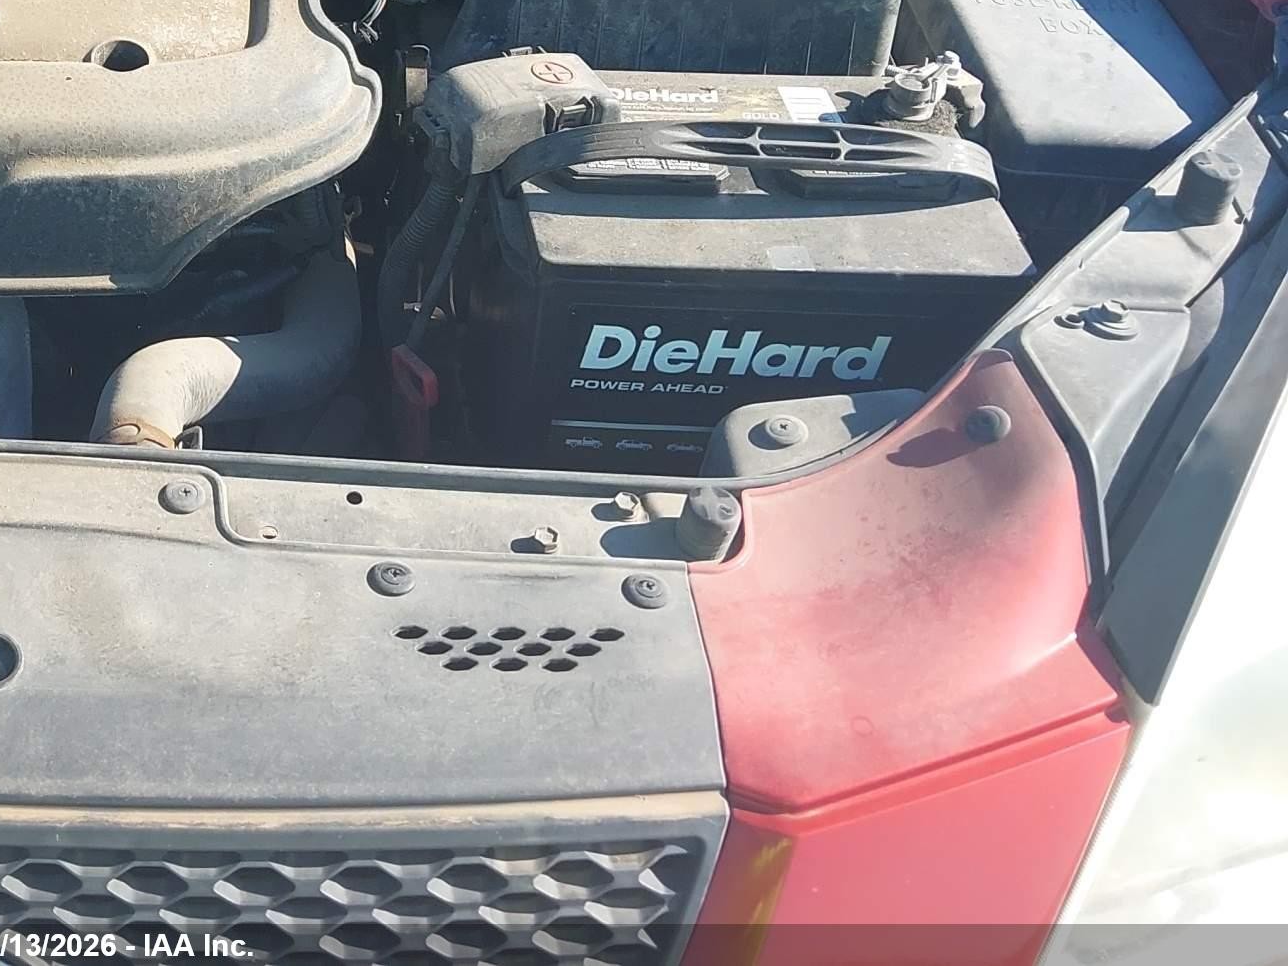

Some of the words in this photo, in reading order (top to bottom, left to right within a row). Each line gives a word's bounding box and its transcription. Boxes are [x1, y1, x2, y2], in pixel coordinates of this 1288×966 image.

[1039, 16, 1103, 36] BOX
[741, 111, 781, 120] GOLD
[579, 324, 892, 381] DieHard
[570, 379, 644, 392] POWER
[650, 383, 725, 395] AHEAD
